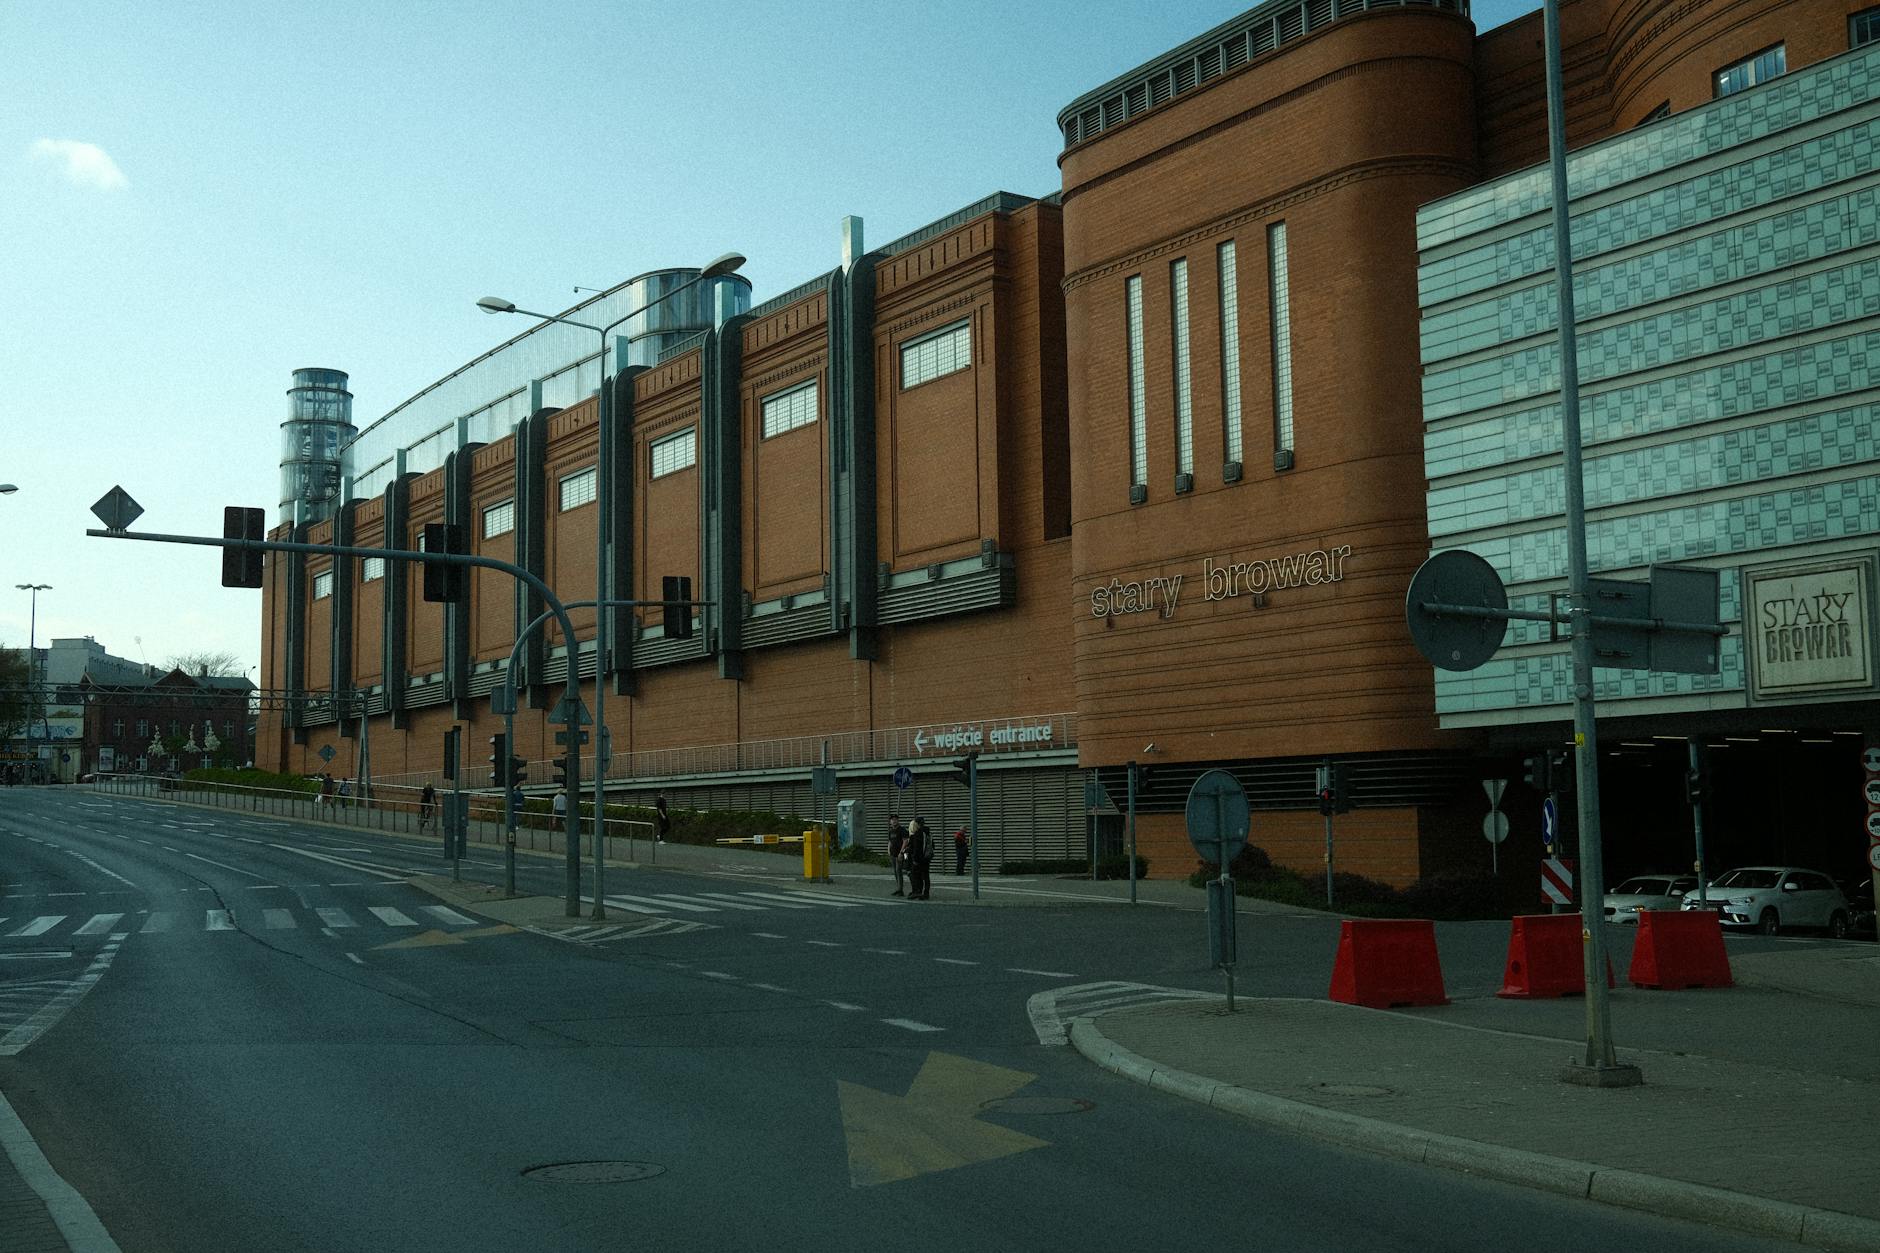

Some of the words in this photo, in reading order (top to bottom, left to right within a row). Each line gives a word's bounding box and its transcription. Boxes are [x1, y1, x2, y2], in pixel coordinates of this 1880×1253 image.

[1091, 573, 1183, 619] stary
[1203, 544, 1351, 601] browar
[1763, 590, 1854, 630] STARY
[1765, 622, 1852, 664] BROWAR
[934, 727, 983, 752] wejście
[989, 724, 1052, 745] entrance
